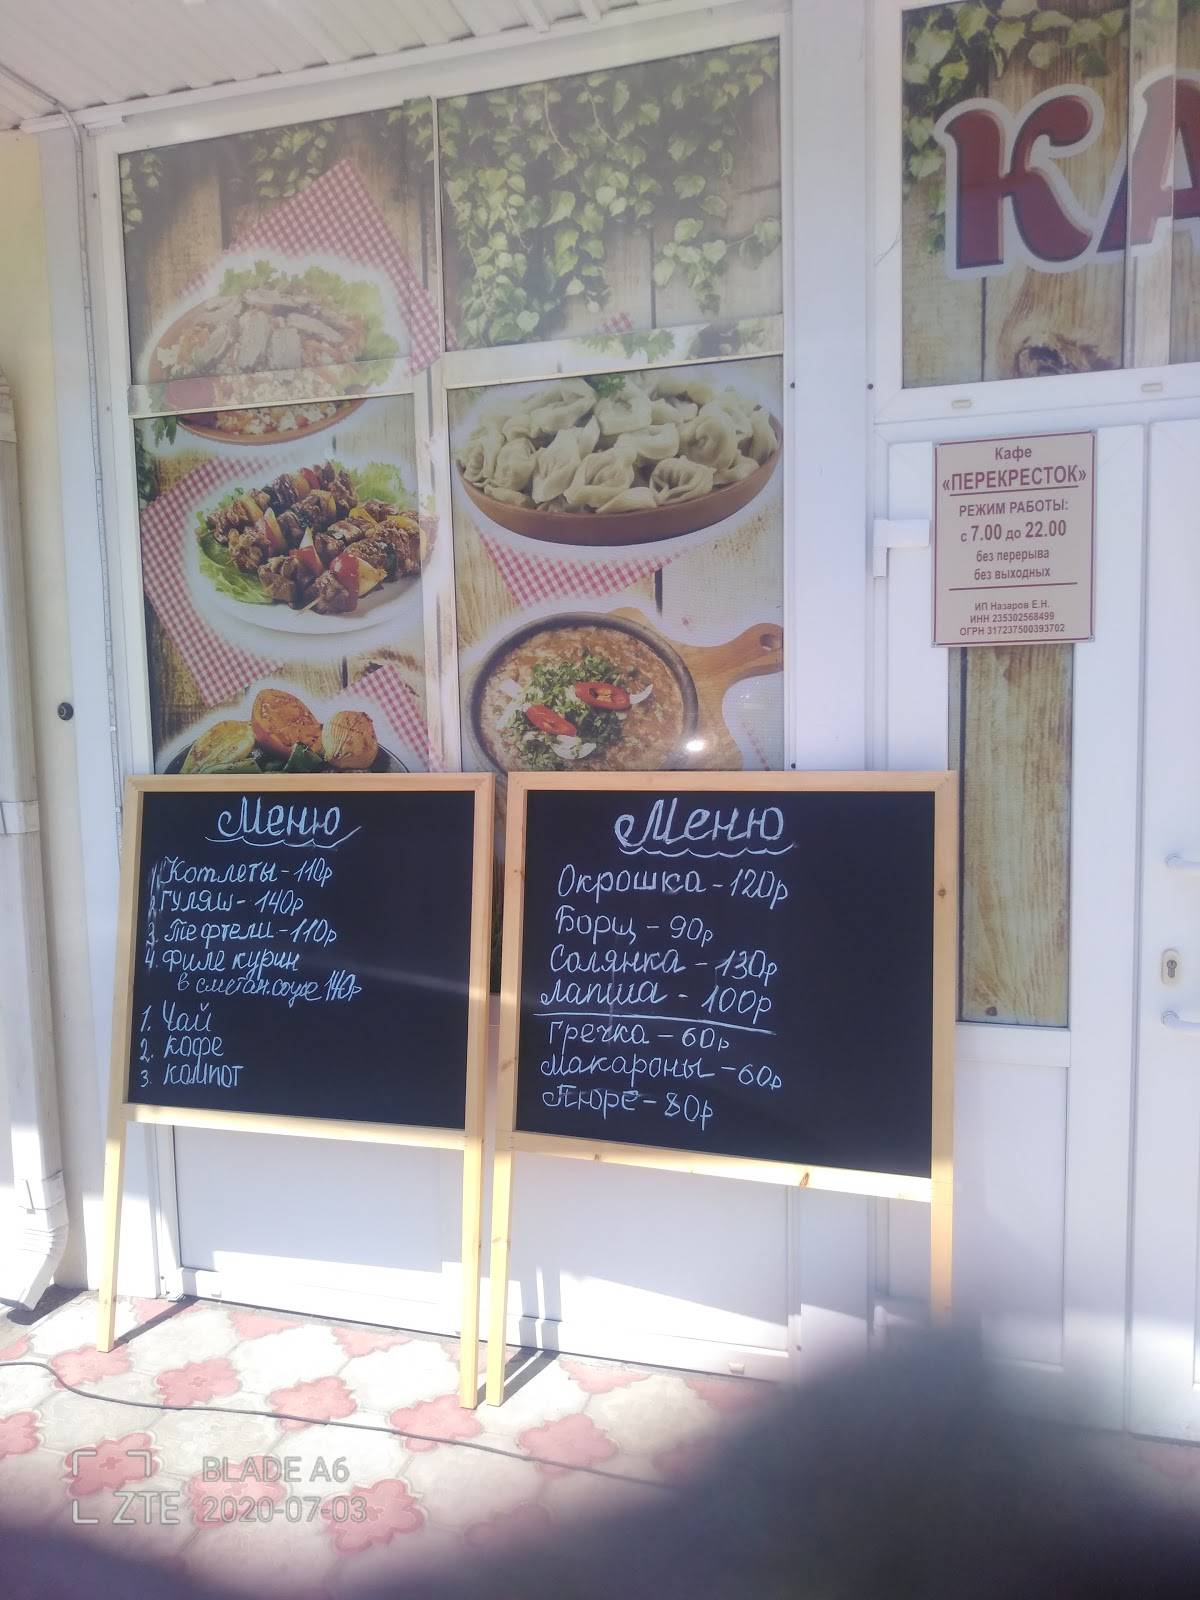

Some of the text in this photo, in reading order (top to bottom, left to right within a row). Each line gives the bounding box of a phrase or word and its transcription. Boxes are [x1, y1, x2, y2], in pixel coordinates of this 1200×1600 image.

[995, 445, 1033, 462] Кафе
[942, 464, 1087, 491] «ПЕРЕКРЕСТОК»
[959, 498, 1069, 517] РЕЖИМ РАБОТЫ:
[960, 519, 1067, 542] с 7.00 до 22.00
[976, 548, 1050, 563] без перерыва
[974, 567, 1051, 580] без выходных
[969, 611, 1055, 624] ИНН 235302568499
[974, 602, 988, 611] ИП
[990, 601, 1029, 611] Назаров
[959, 623, 1065, 636] ОГРН 317237500393702
[217, 796, 341, 838] Меню
[614, 797, 785, 848] Меню
[160, 856, 278, 885] Котлеты
[557, 863, 707, 904] Окрошка
[555, 905, 637, 945] Борщ
[162, 949, 226, 972] Филе
[550, 943, 687, 973] Солянка
[177, 972, 190, 991] в
[162, 1000, 212, 1032] Чай
[549, 1020, 650, 1055] Гречка
